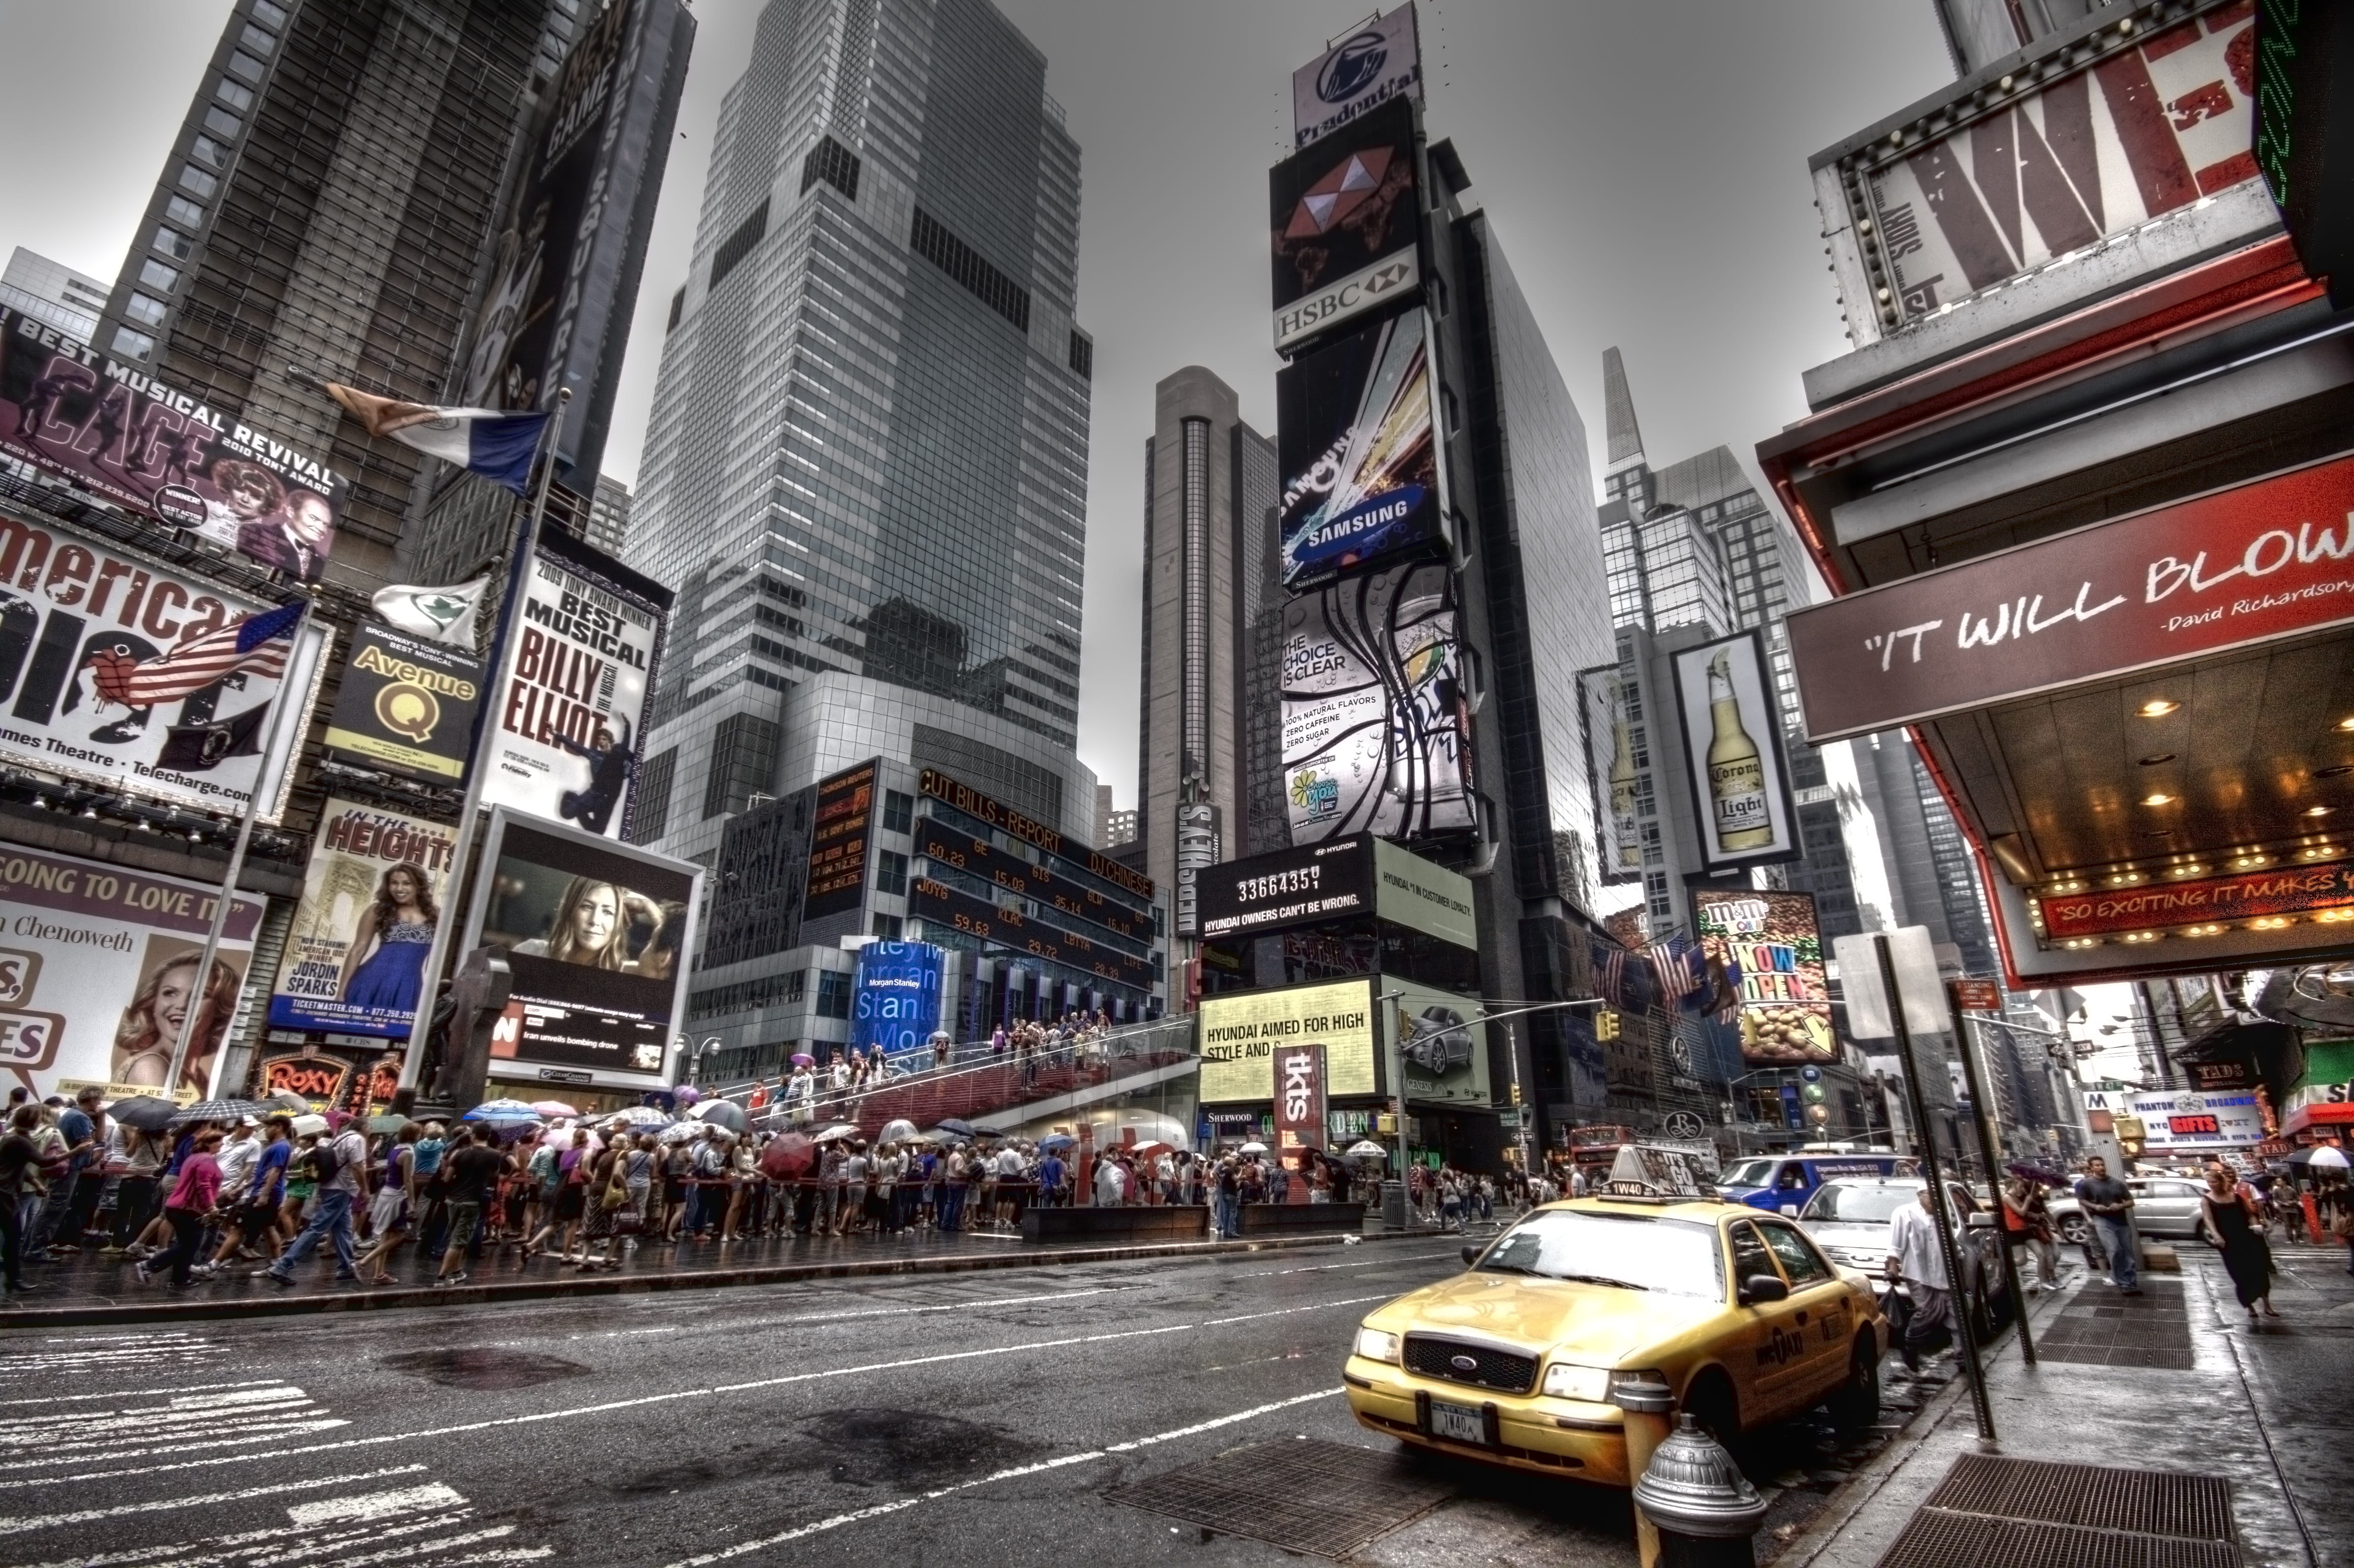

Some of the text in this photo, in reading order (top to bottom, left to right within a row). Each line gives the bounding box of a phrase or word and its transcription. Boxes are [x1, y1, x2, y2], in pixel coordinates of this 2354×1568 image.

[1296, 65, 1419, 147] Prudential
[540, 168, 608, 411] SQUARE
[1279, 282, 1361, 338] HSBC
[18, 317, 334, 487] BEST MUSICAL REVIVAL
[4, 442, 25, 456] 220
[222, 437, 331, 495] 2010 TONY AWARD
[162, 503, 181, 513] BEST
[166, 488, 201, 505] WINNER!
[1309, 500, 1407, 547] SAMSUNG
[1295, 572, 1333, 589] SHERWOOD
[1957, 511, 2354, 650] WILL BLOW
[537, 561, 651, 631] 2009 TONY AWARD WINNER
[558, 590, 626, 637] BEST
[366, 626, 418, 649] BROADWAY'S
[524, 596, 646, 671] MUSICAL
[1283, 635, 1306, 655] THE
[389, 642, 453, 667] BEST MUSICAL
[515, 626, 605, 706] BILLY
[1283, 642, 1336, 672] CHOICE
[353, 646, 476, 700] Avenue
[1284, 655, 1346, 688] IS CLEAR
[375, 681, 440, 743] Q
[1285, 696, 1376, 726] 100% NATURAL FLAVORS
[1286, 714, 1340, 737] ZERO CAFFEINE
[1286, 728, 1329, 748] ZERO SUGAR
[47, 738, 114, 766] Theatre
[1711, 763, 1759, 783] Corona
[1720, 797, 1762, 818] Light
[344, 809, 409, 831] IN THE
[920, 770, 1150, 899] CUT BILLS REPORT DJ CHINESE
[1327, 841, 1357, 853] HYUNDAI
[84, 873, 194, 917] TO LOVE
[1422, 888, 1450, 908] CUSTOMER
[2097, 873, 2337, 918] EXCITING IT MAKES
[1205, 894, 1360, 932] HYUNDAI OWNERS CAN'T BE WRONG.
[14, 915, 133, 953] Chenoweth
[298, 945, 331, 956] AMERICAN
[1735, 945, 1794, 973] NOW
[293, 961, 340, 981] JORDIN
[287, 976, 338, 996] SPARKS
[894, 979, 920, 989] Stanley
[1743, 975, 1807, 1000] OPEN
[293, 999, 364, 1014] TICKETMASTER.COM
[1208, 1012, 1364, 1042] HYUNDAI AIMED FOR HIGH
[354, 1038, 370, 1046] CBS
[524, 1031, 619, 1050] Iran unveils bombing drone
[1209, 1042, 1270, 1060] STYLE AND
[2197, 1064, 2244, 1079] TADS
[1285, 1052, 1312, 1122] tkts
[1407, 1079, 1432, 1092] GENESIS
[2135, 1096, 2256, 1112] PHANTOM BROADWAY
[1209, 1113, 1252, 1122] SHERWOOD
[2172, 1116, 2217, 1133] GIFTS
[1613, 1183, 1641, 1195] 1W40
